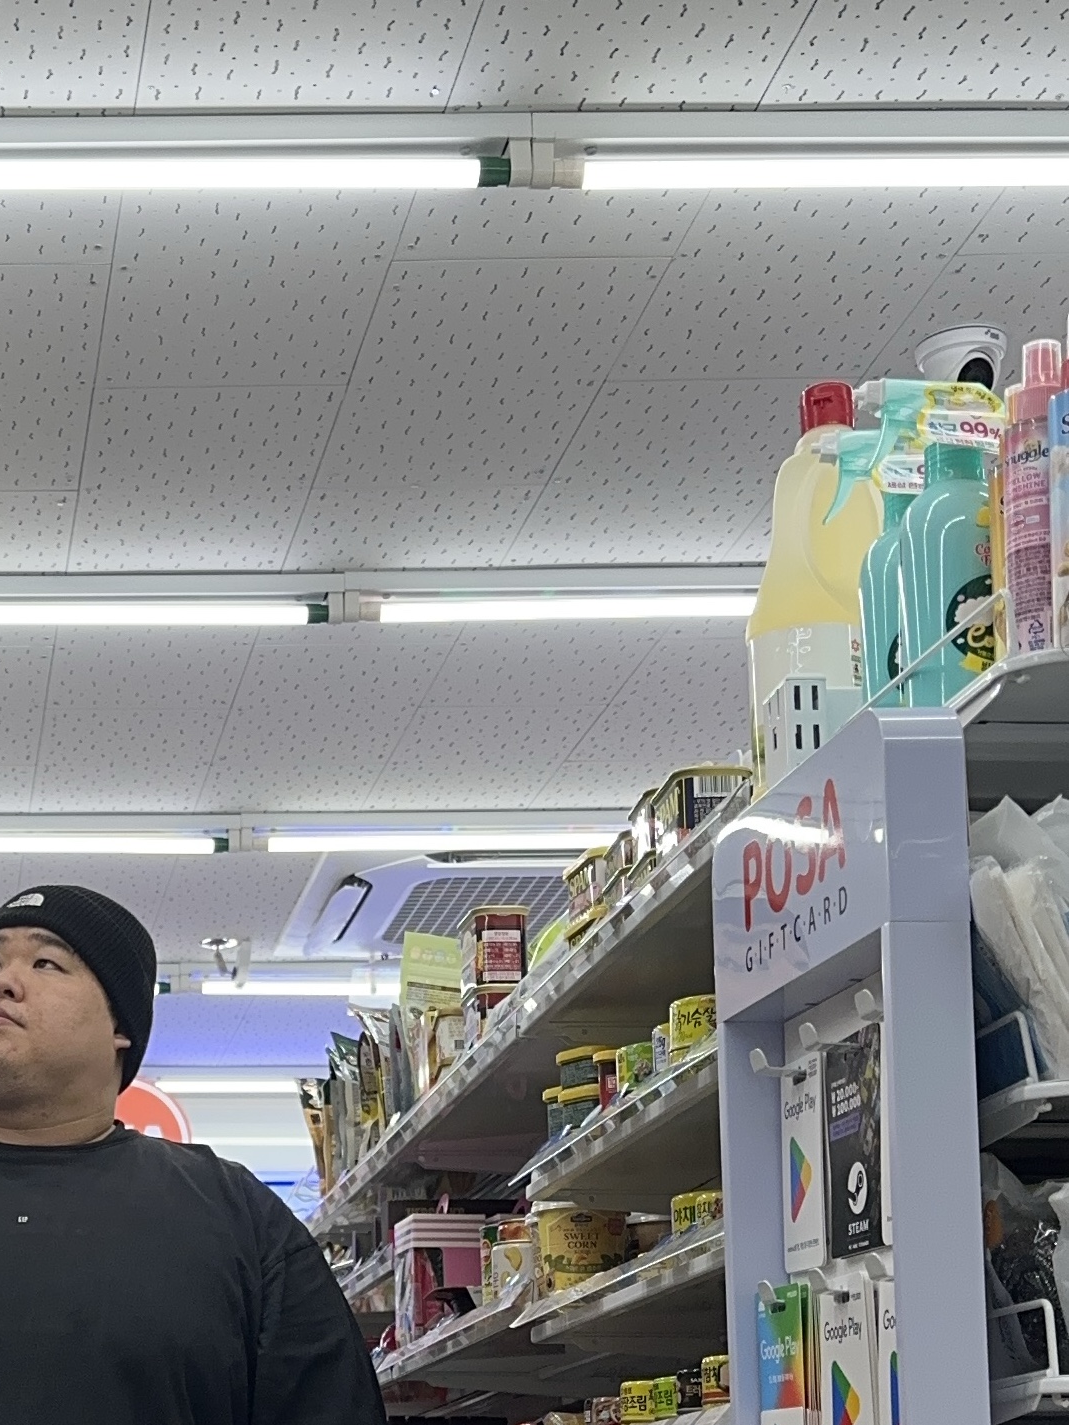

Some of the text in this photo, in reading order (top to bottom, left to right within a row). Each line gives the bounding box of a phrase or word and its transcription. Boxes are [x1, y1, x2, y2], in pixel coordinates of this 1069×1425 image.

[960, 420, 1001, 440] 99%
[742, 778, 846, 932] POSA
[784, 1092, 816, 1121] Google Play
[563, 1232, 600, 1241] SWEET
[848, 1218, 870, 1236] STEAM
[567, 1241, 598, 1250] CORN
[824, 1319, 849, 1344] Google
[848, 1316, 863, 1340] Play
[760, 1337, 785, 1364] Google
